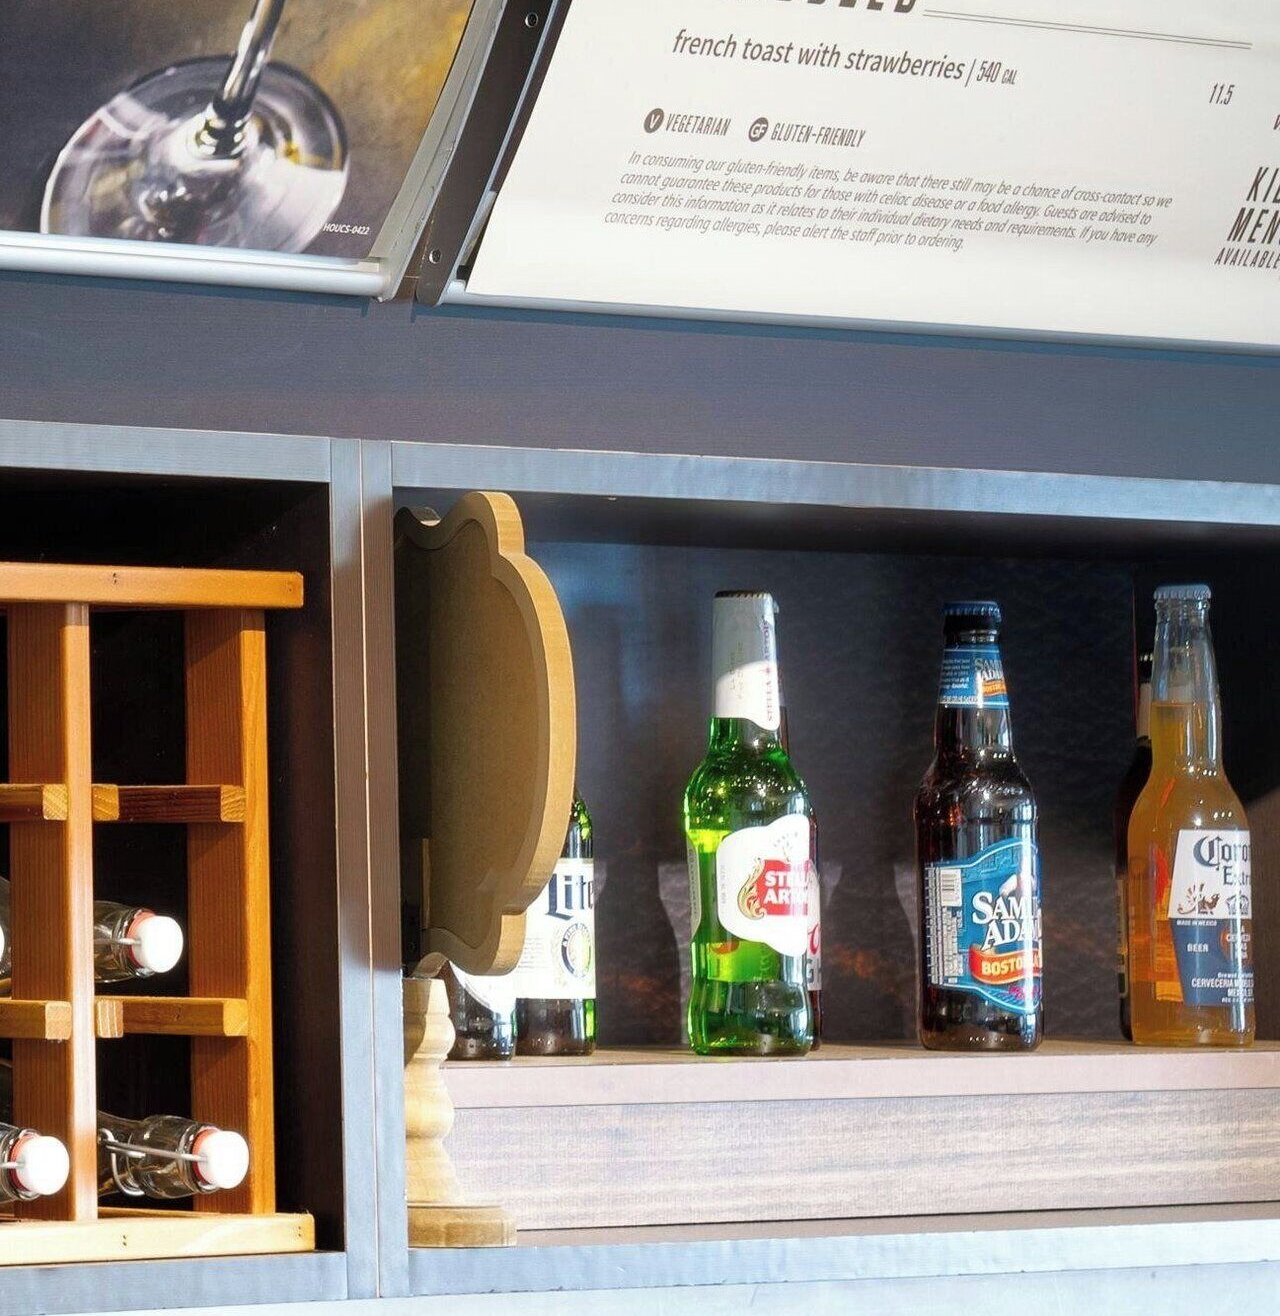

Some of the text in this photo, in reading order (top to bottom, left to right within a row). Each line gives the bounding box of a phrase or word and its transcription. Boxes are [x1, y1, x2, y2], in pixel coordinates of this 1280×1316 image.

[672, 28, 1017, 84] french toast with strawberries 540 CAL
[1209, 84, 1235, 105] 11.5
[665, 113, 732, 136] VEGETARIAN
[771, 122, 867, 148] GLUTEN-FRIENDLY
[620, 173, 1152, 225] cannot guarantee these products for those with celiac disease or a food allergy. Guests are advised to
[628, 150, 1173, 208] In consuming our gluten-friendly items, be aware that there still may be a chance of cross-contact so we
[604, 211, 963, 252] concerns regarding allergies, please alert the staff prior to ordering.
[611, 191, 1158, 247] consider this information as it relates to their individual dietary needs and requirements. If you have any
